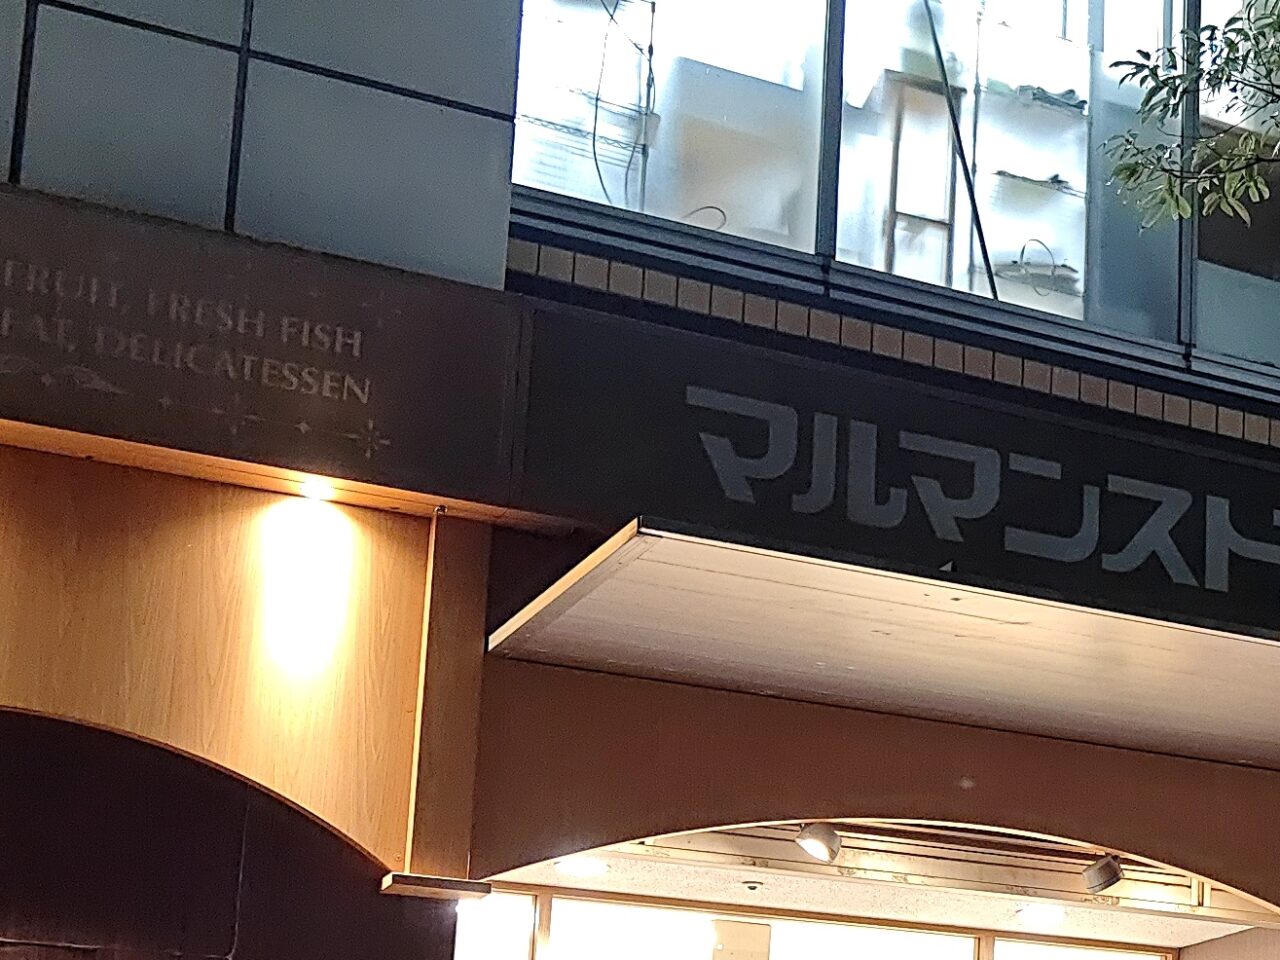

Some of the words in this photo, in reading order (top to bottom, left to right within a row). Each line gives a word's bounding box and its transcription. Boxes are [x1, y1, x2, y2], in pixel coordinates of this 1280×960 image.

[146, 288, 266, 338] FRESH
[279, 315, 364, 358] FISH
[94, 325, 372, 405] DELICATESSEN
